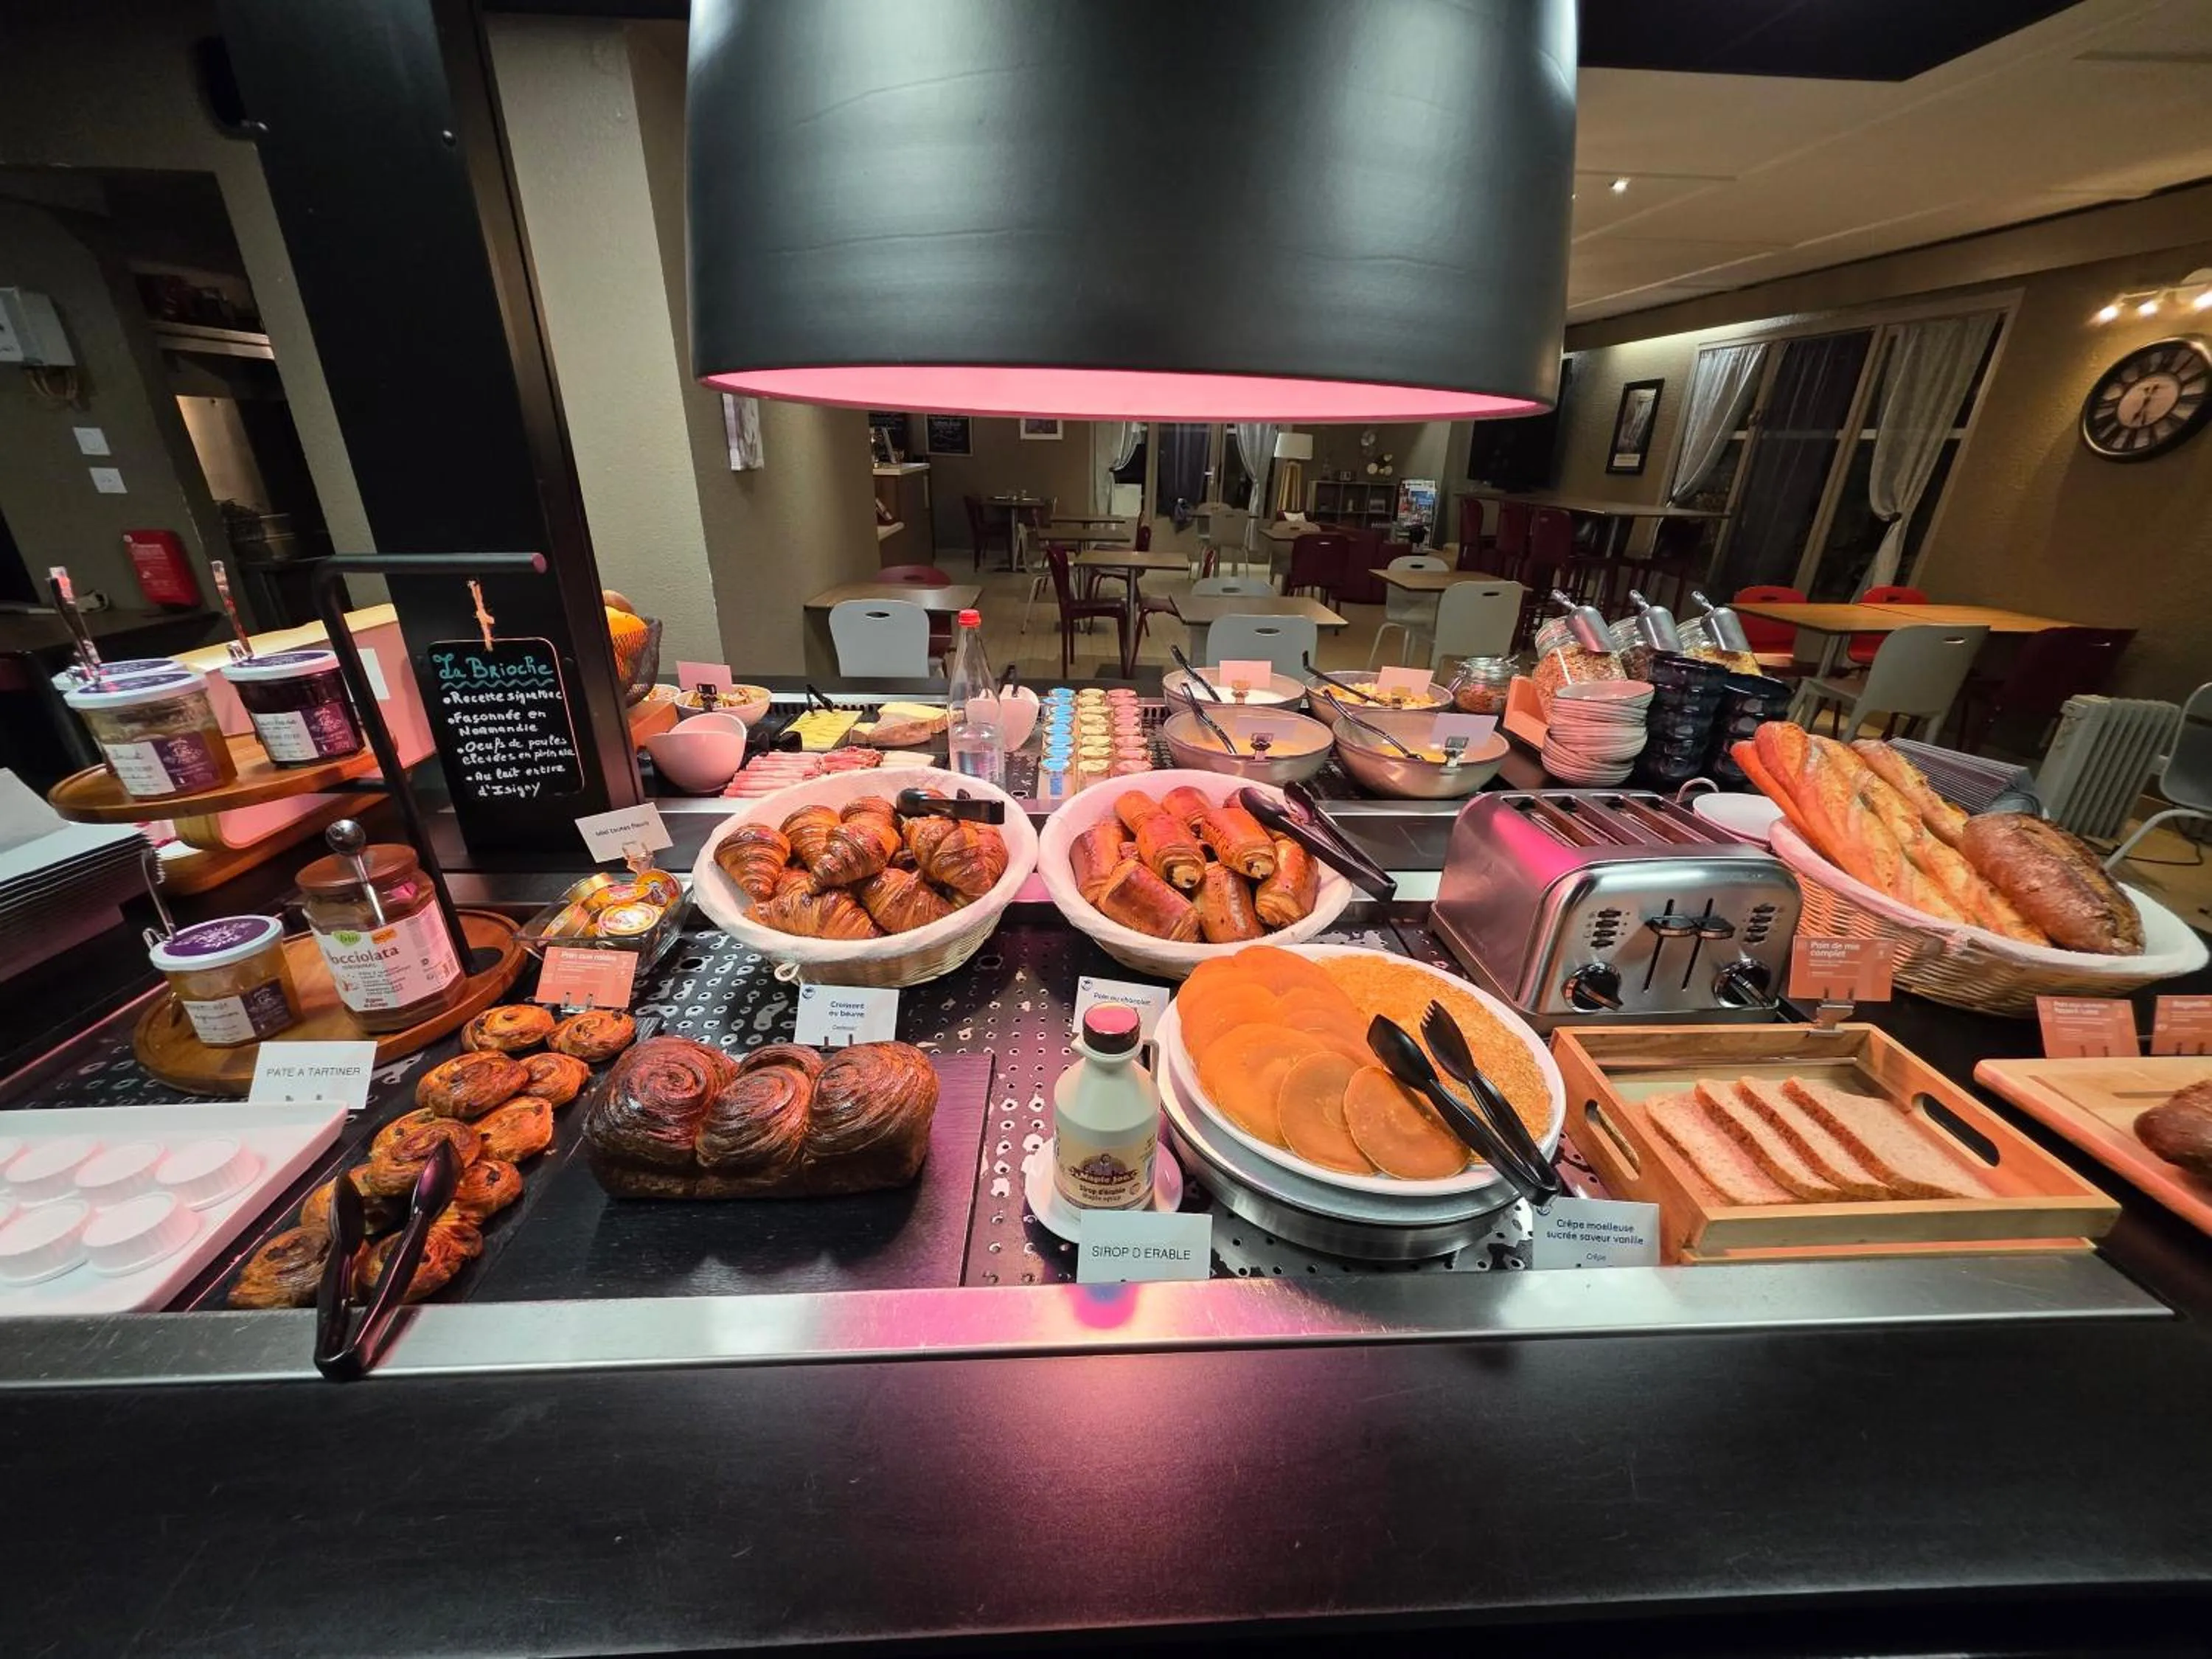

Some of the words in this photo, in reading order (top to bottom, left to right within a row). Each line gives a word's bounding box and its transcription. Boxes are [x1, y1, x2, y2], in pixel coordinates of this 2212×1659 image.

[528, 710, 546, 720] en
[509, 739, 524, 748] de
[496, 767, 521, 779] lait
[308, 1067, 361, 1078] TARTINER
[1557, 1219, 1585, 1230] Crêpe
[1547, 1230, 1577, 1240] sucrée
[1580, 1234, 1611, 1243] saveur
[1092, 1245, 1130, 1258] SIROP
